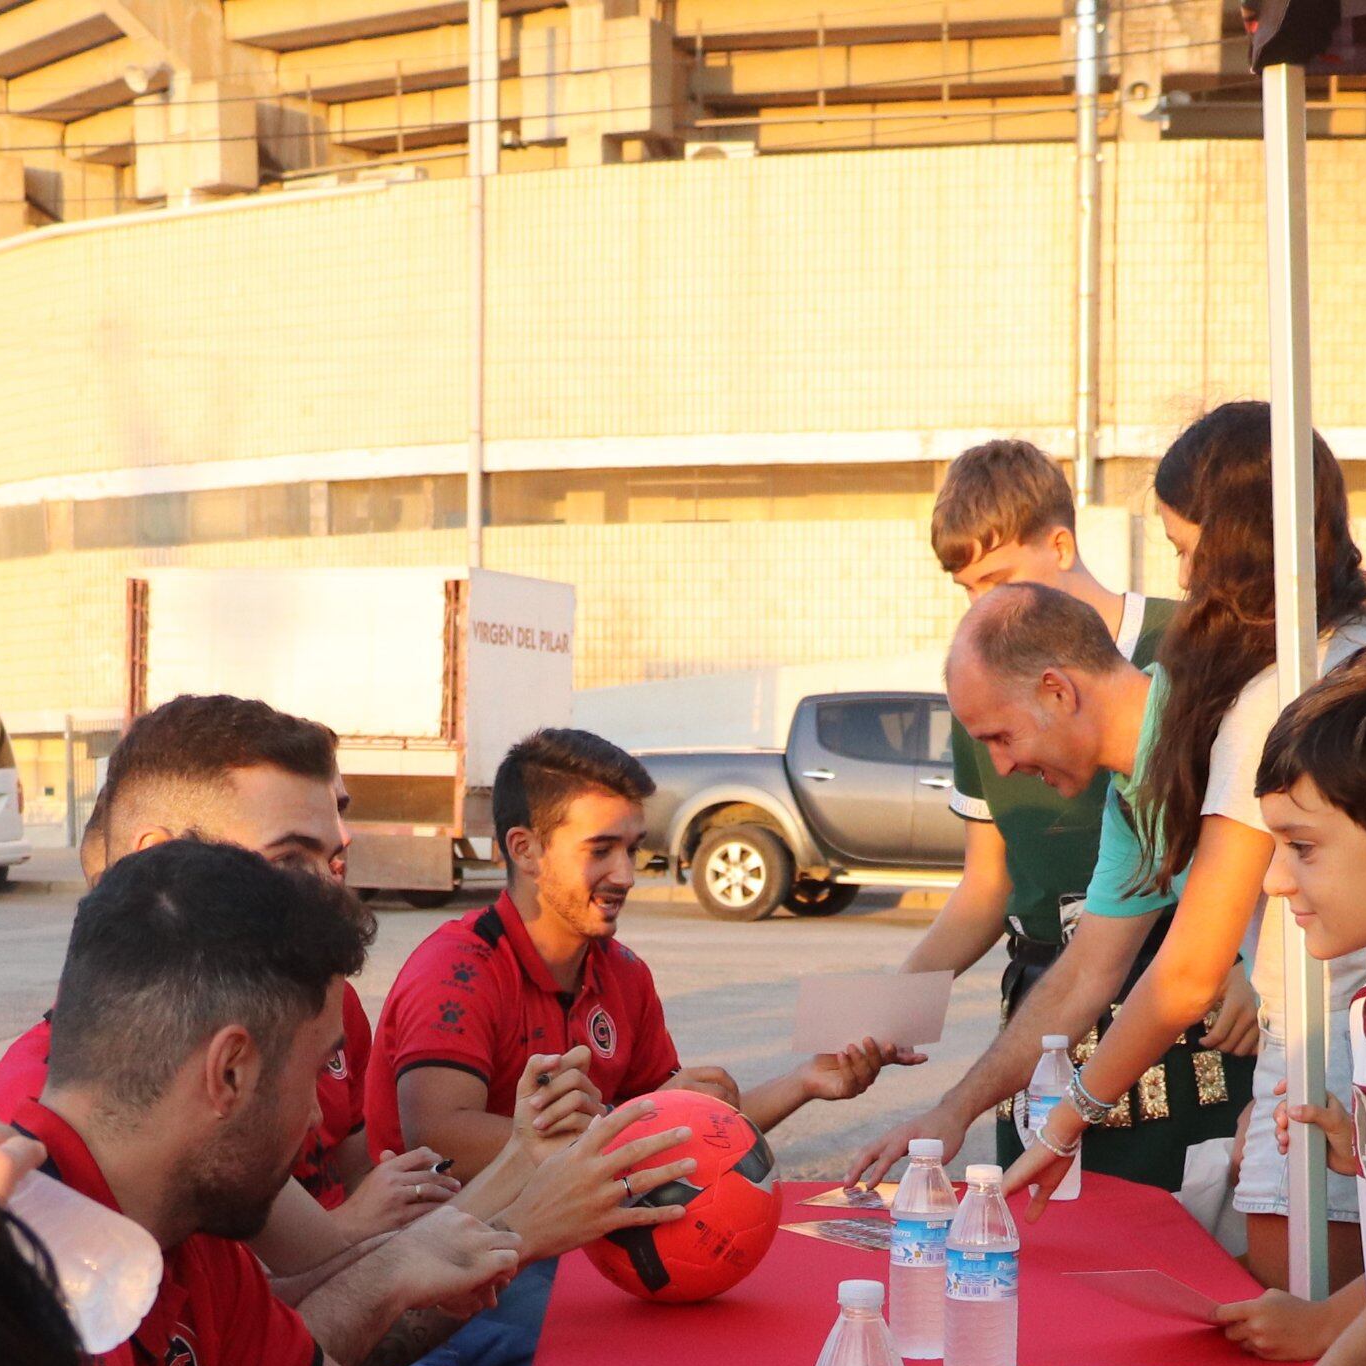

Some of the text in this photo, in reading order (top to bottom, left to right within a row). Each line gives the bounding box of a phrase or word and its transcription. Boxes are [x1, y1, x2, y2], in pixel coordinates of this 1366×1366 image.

[473, 620, 570, 654] VIRGEN DEL PILAR
